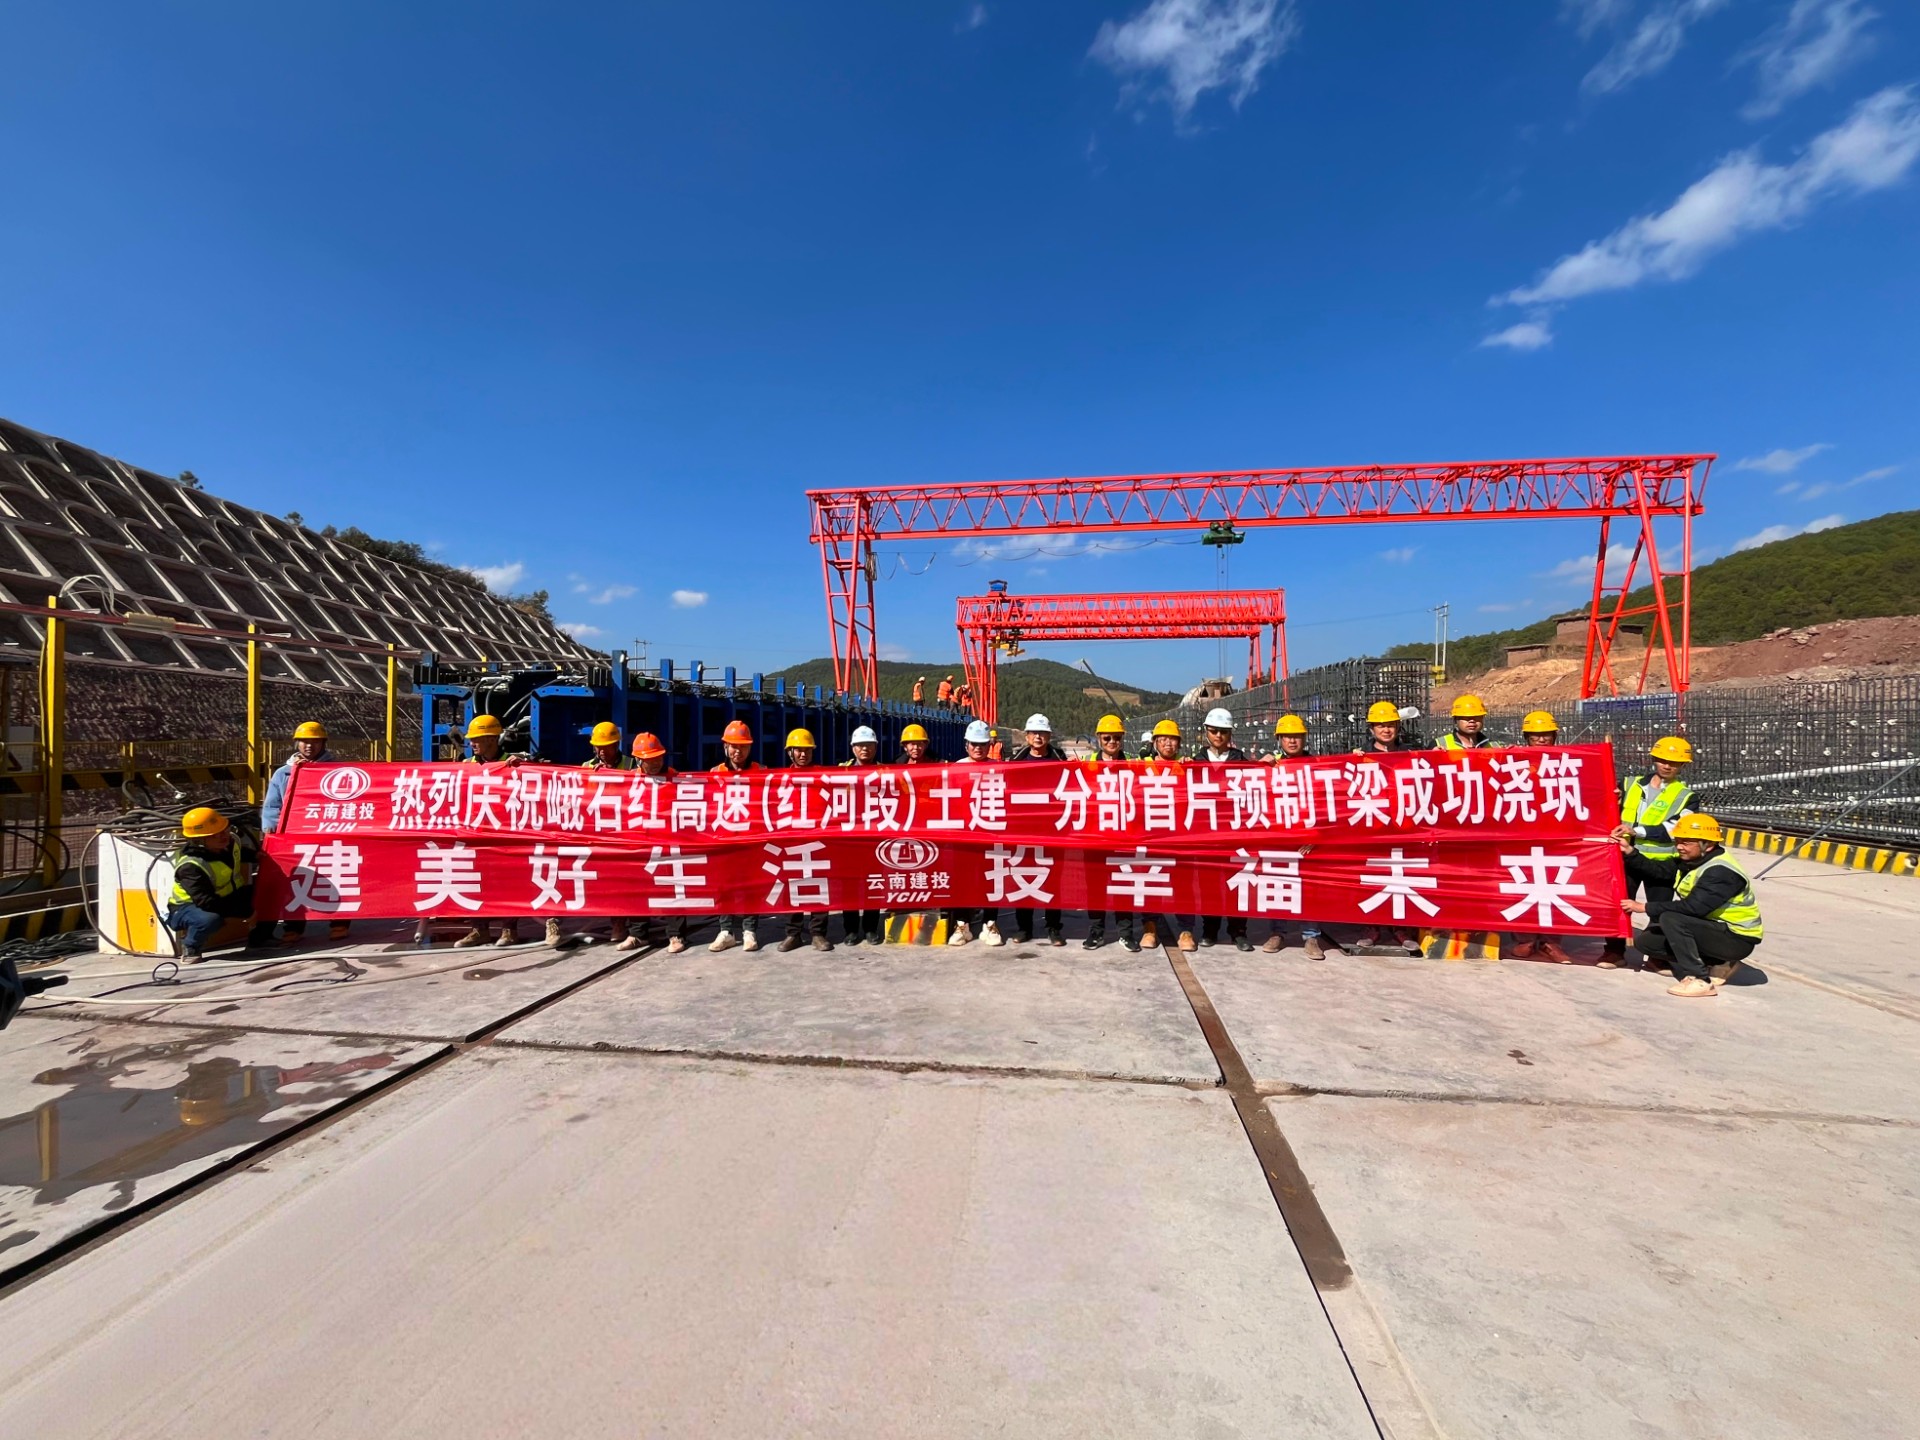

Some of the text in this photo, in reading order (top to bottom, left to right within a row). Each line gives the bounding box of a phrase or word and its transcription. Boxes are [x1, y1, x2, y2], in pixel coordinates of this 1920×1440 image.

[304, 802, 375, 820] 云南建投
[316, 822, 358, 832] YCIH
[285, 840, 831, 912] 建美好生活
[866, 871, 950, 890] 云南建投
[886, 891, 932, 903] YCIH
